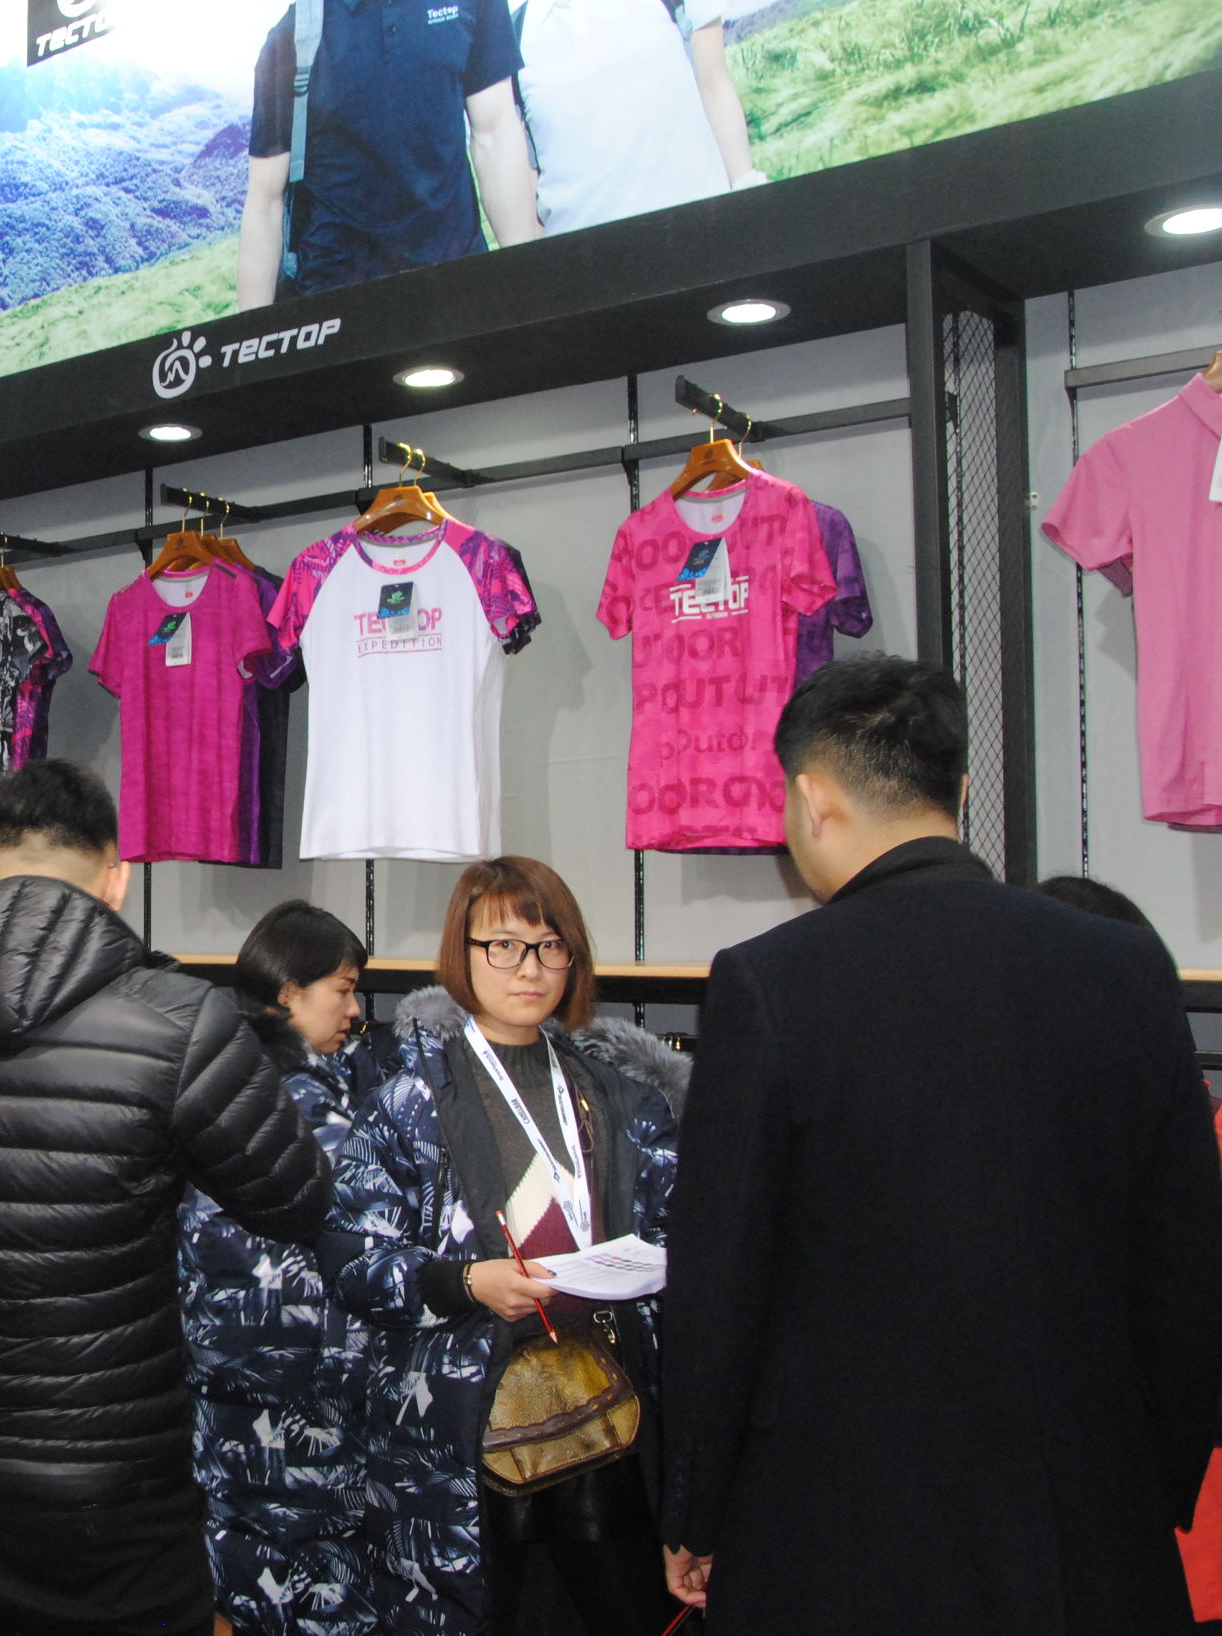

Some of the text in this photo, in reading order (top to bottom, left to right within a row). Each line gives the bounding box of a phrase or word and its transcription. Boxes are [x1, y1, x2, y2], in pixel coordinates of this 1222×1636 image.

[36, 11, 111, 57] TECTO
[220, 318, 341, 367] TECTOP
[355, 607, 443, 636] TEOP
[357, 637, 442, 654] EXPEDITION
